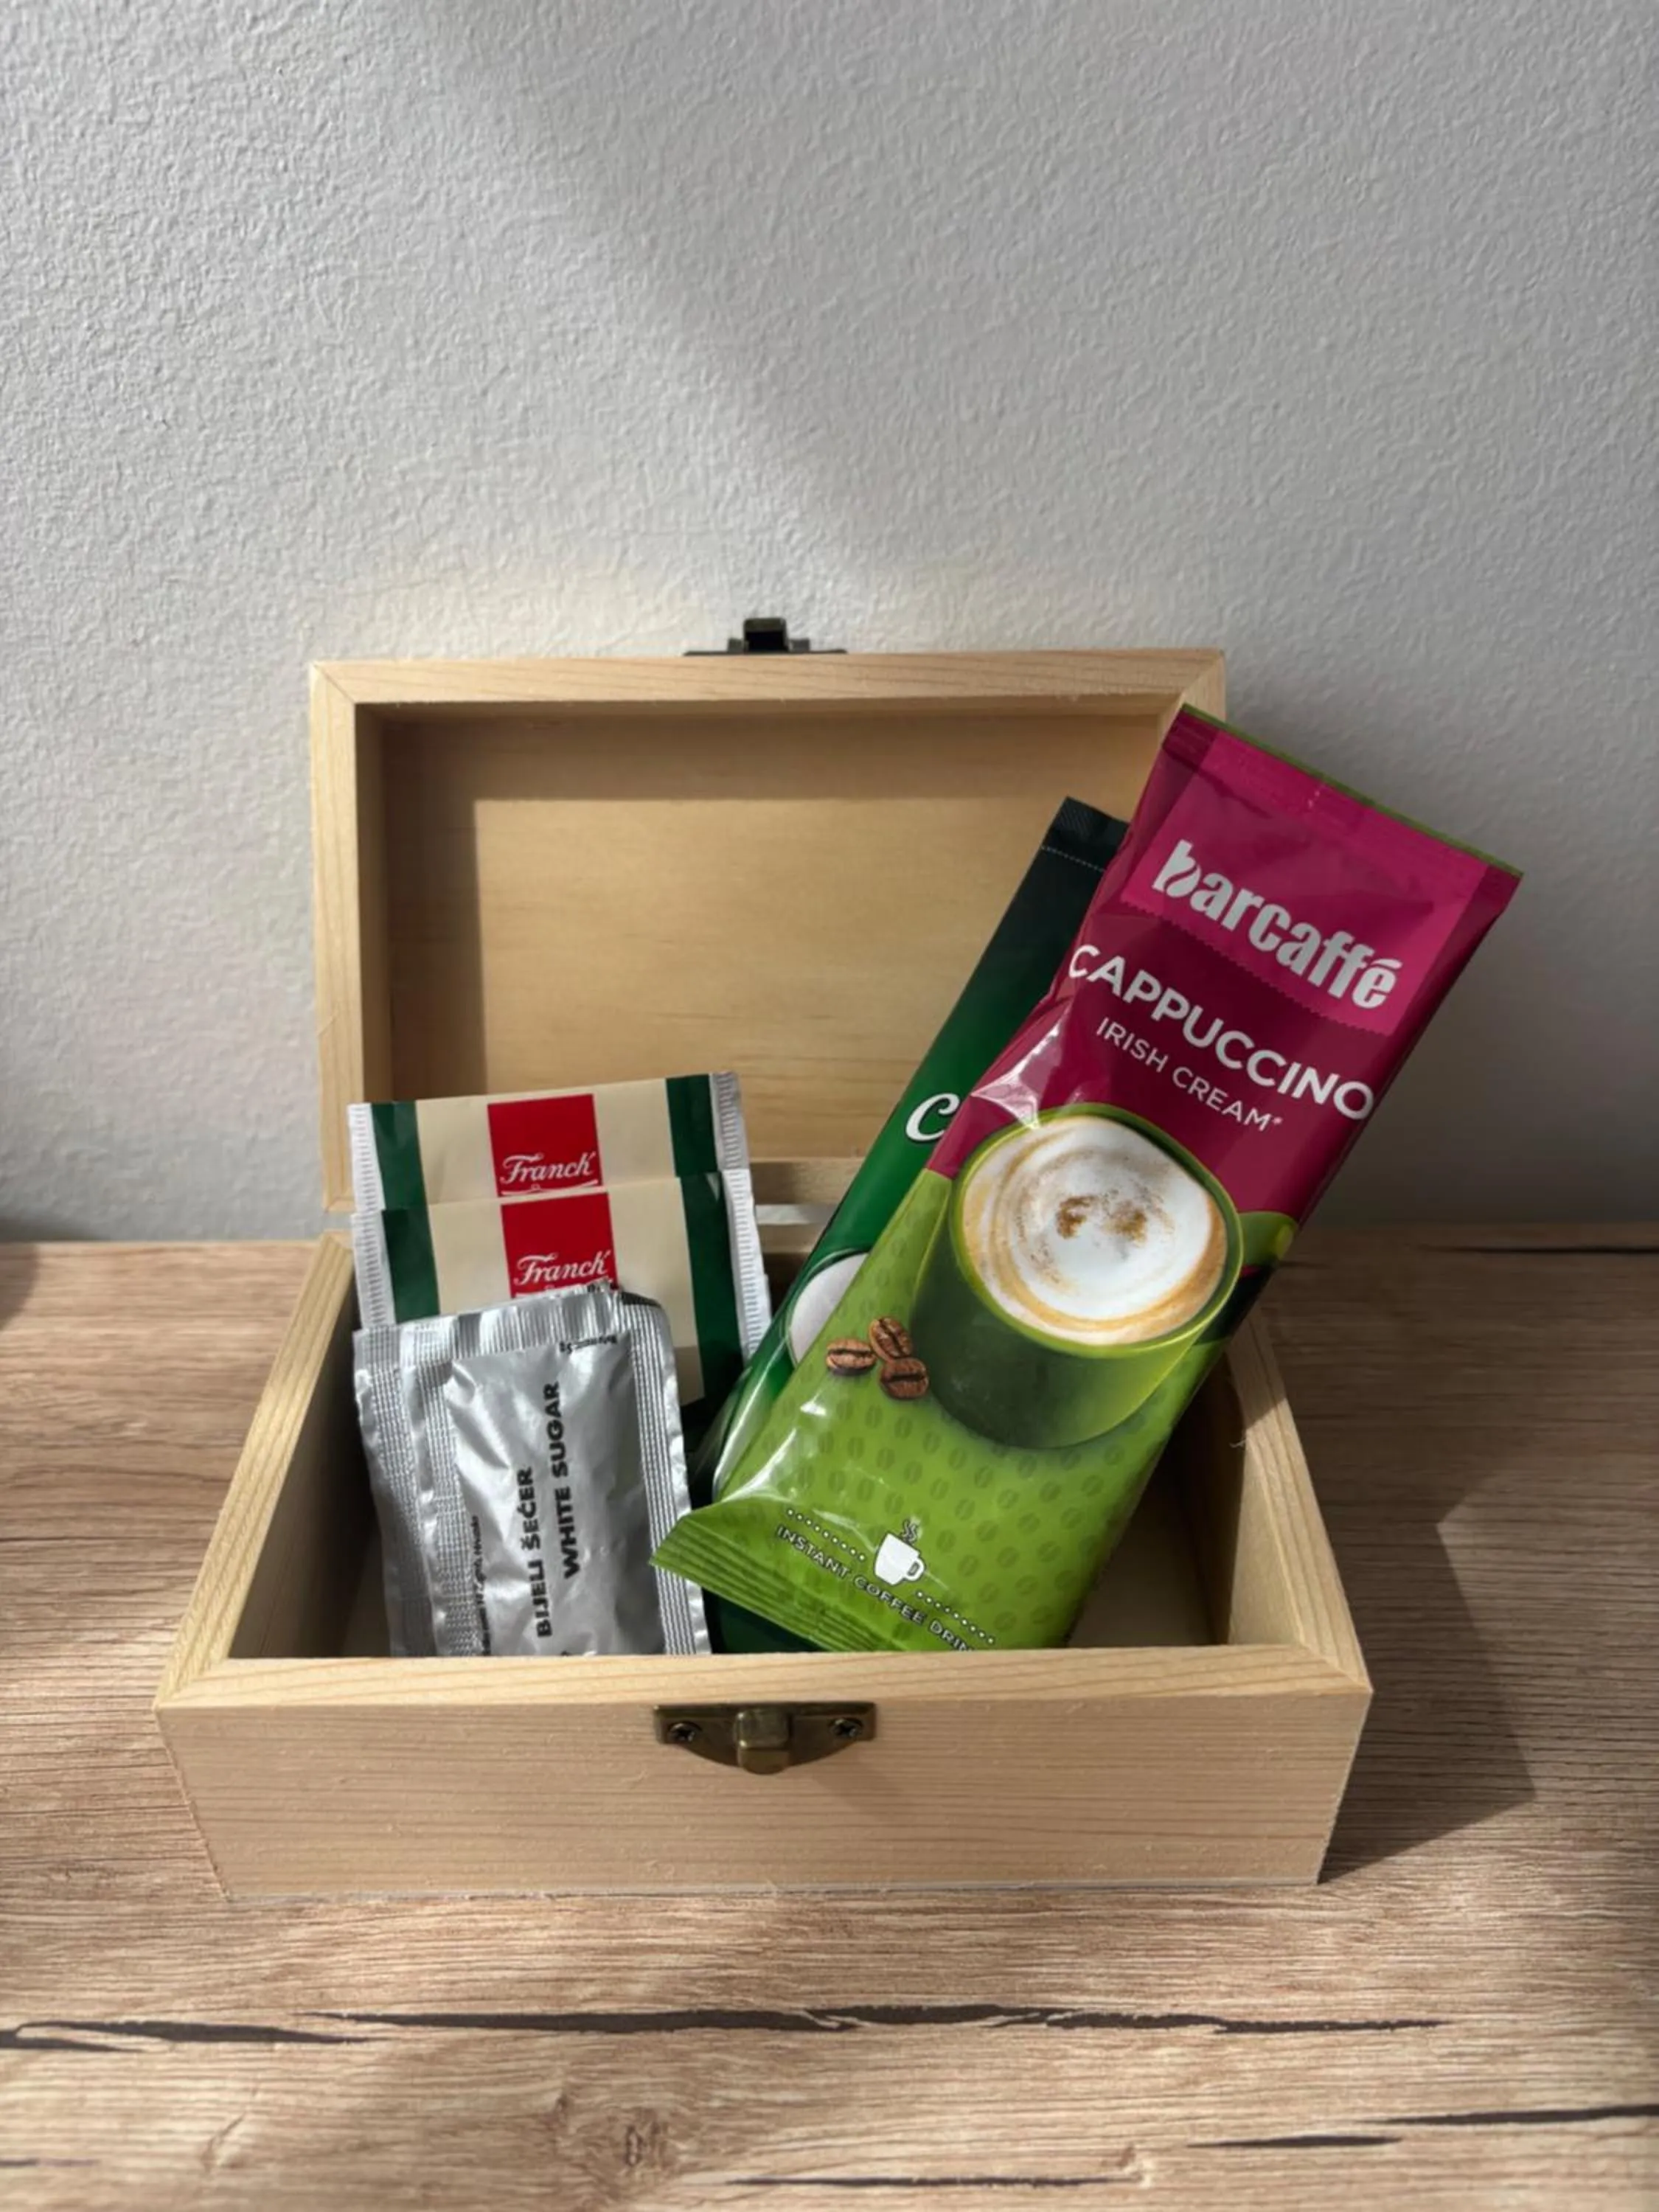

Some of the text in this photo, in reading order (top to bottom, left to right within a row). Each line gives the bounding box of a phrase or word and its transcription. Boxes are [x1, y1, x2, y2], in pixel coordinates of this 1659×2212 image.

[1151, 839, 1402, 1009] barcaffé
[1069, 944, 1374, 1120] CAPPUCCINO
[1096, 1017, 1169, 1073] IRISH
[499, 1151, 597, 1184] Franck
[513, 1250, 611, 1286] Franck
[543, 1380, 580, 1579] WHITE SUGAR
[517, 1467, 552, 1638] BIJELI ŠEĆER
[776, 1524, 851, 1579] INSTANT
[854, 1574, 926, 1624] COFFEE
